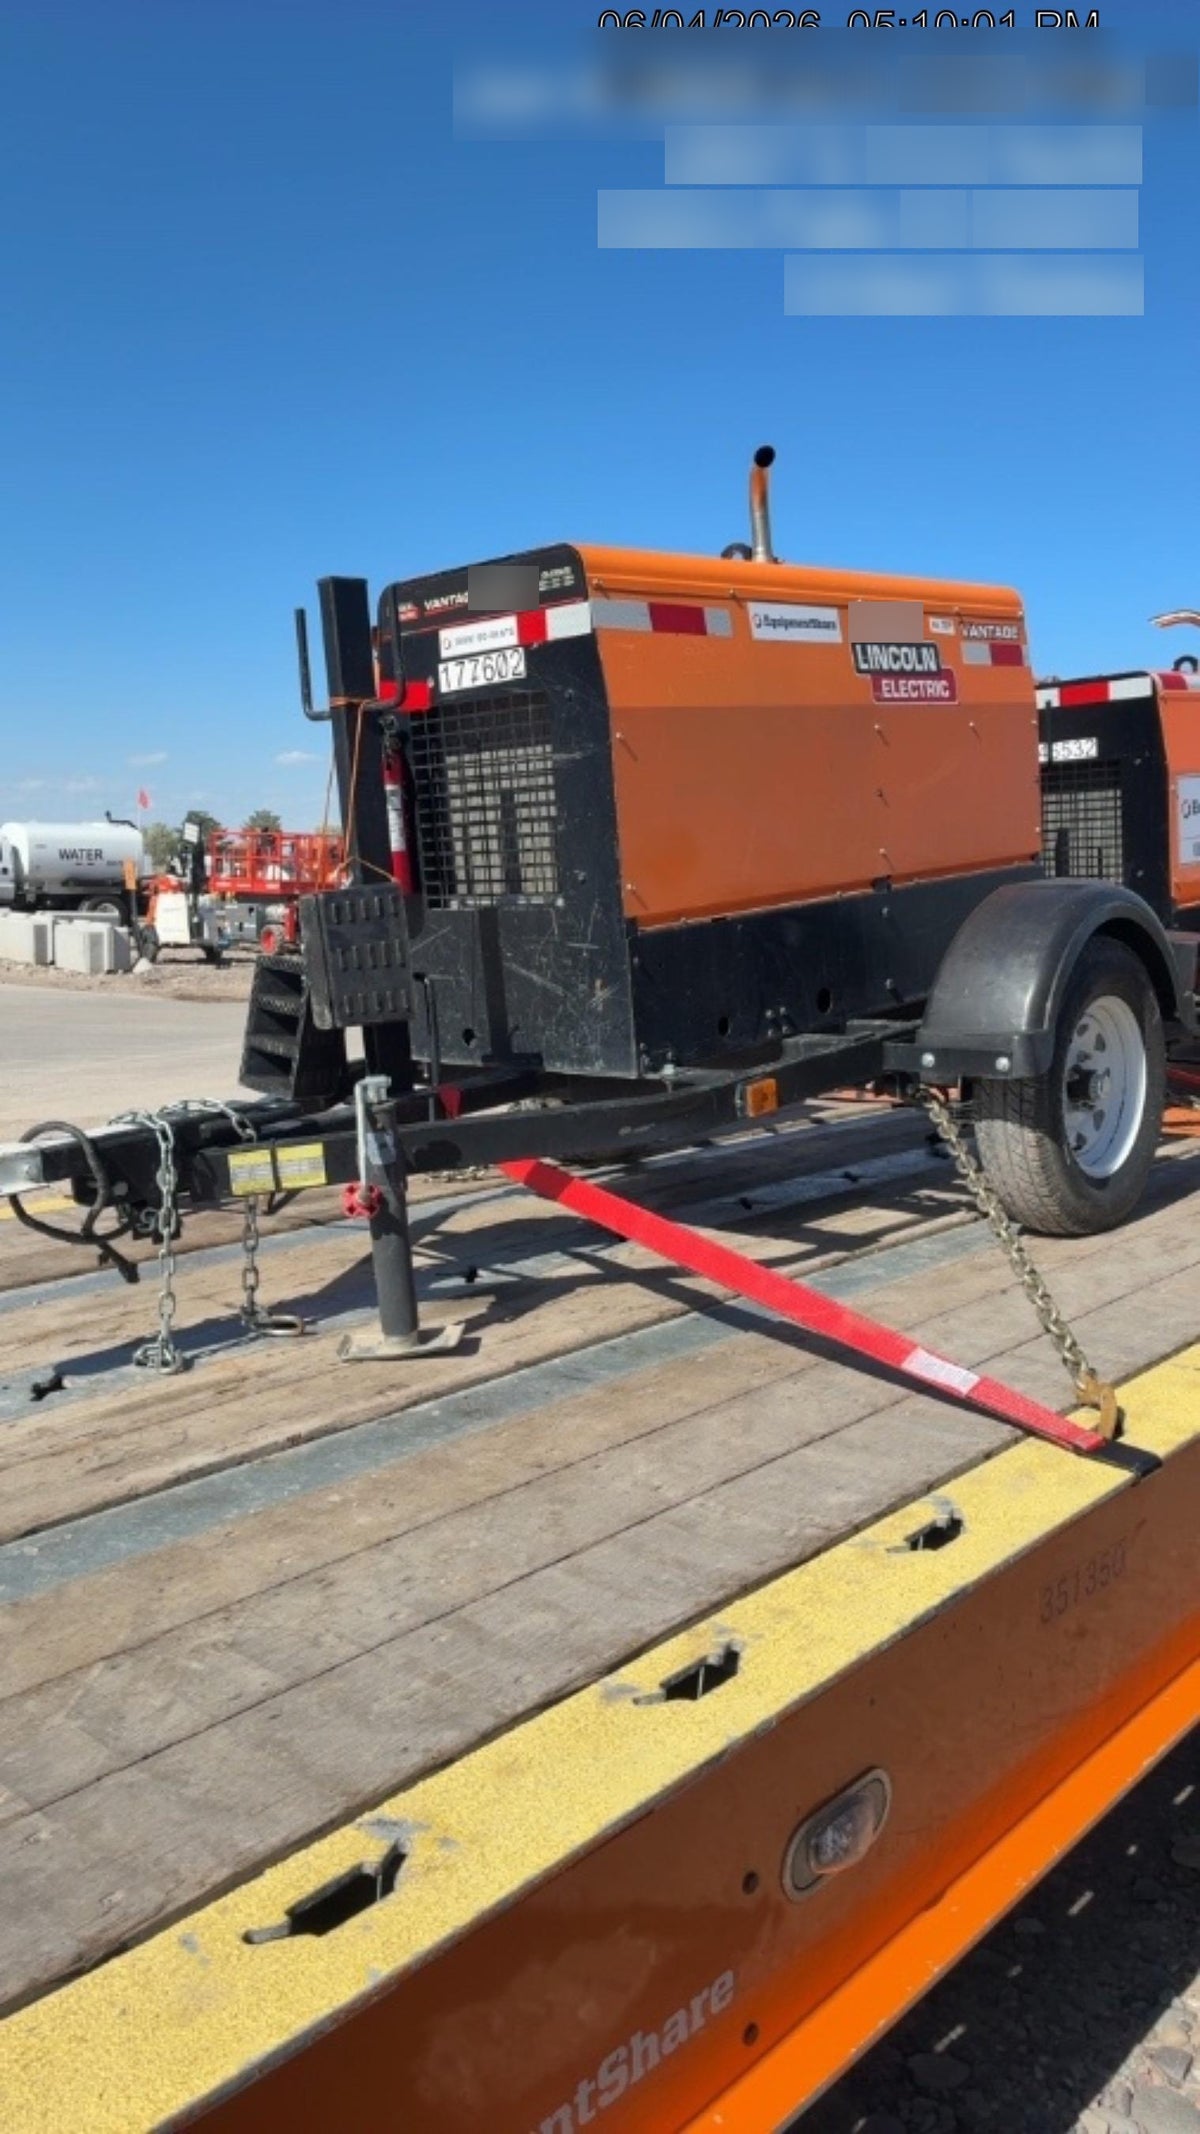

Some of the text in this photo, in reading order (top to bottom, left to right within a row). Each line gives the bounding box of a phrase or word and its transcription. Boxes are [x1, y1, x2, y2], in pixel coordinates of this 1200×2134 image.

[962, 623, 1019, 640] VANTAGE
[440, 649, 524, 690] 177602
[854, 643, 938, 673] LINCOLN
[881, 679, 950, 699] ELECTRIC
[58, 848, 104, 861] WATER
[529, 1969, 735, 2134] ntShare
